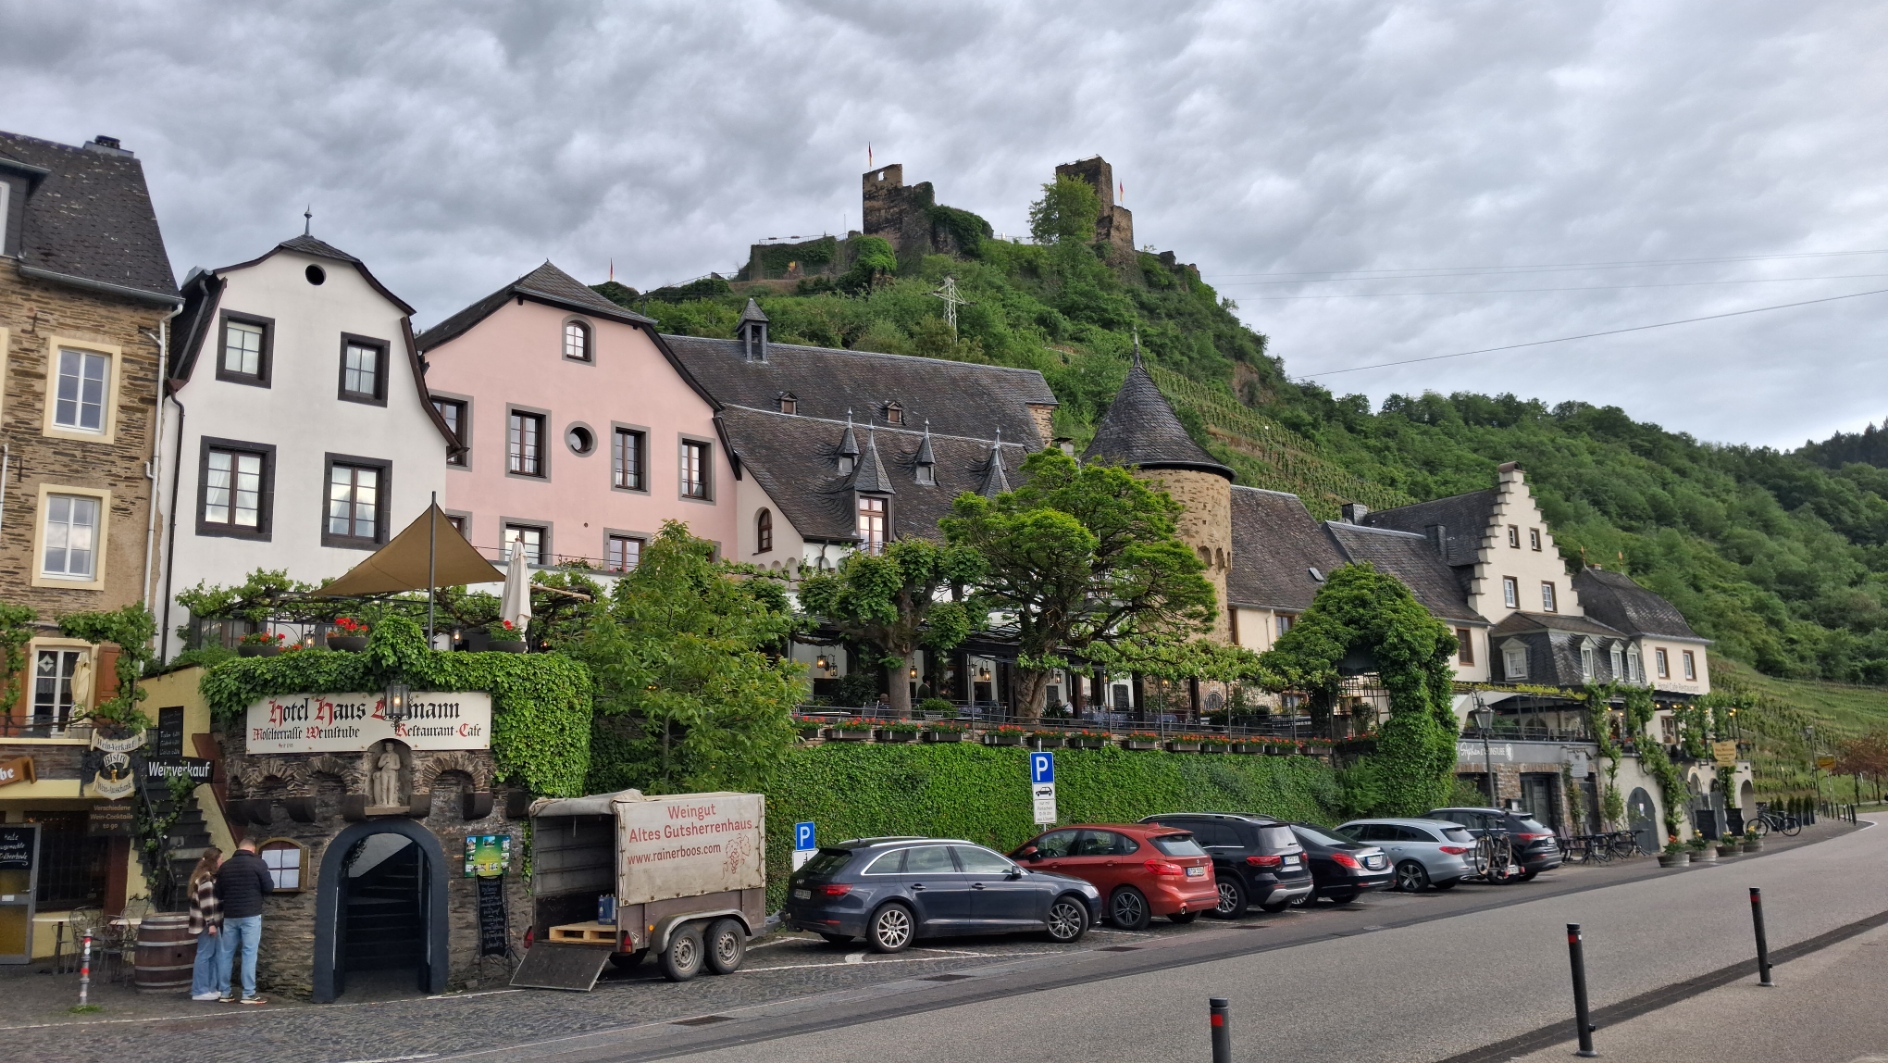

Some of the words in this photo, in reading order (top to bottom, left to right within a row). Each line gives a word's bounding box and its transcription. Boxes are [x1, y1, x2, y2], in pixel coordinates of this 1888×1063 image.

[268, 697, 310, 728] Hotel
[314, 696, 367, 727] Haus
[370, 697, 461, 721] Lmann
[306, 725, 361, 739] Weinstube
[148, 761, 210, 777] Weinverkauf
[1035, 756, 1049, 781] P
[668, 804, 716, 821] Weingut
[629, 827, 661, 844] Altes
[664, 818, 753, 840] Gutsherrenhaus
[800, 826, 811, 847] P
[627, 844, 721, 866] www.rainerboos.com
